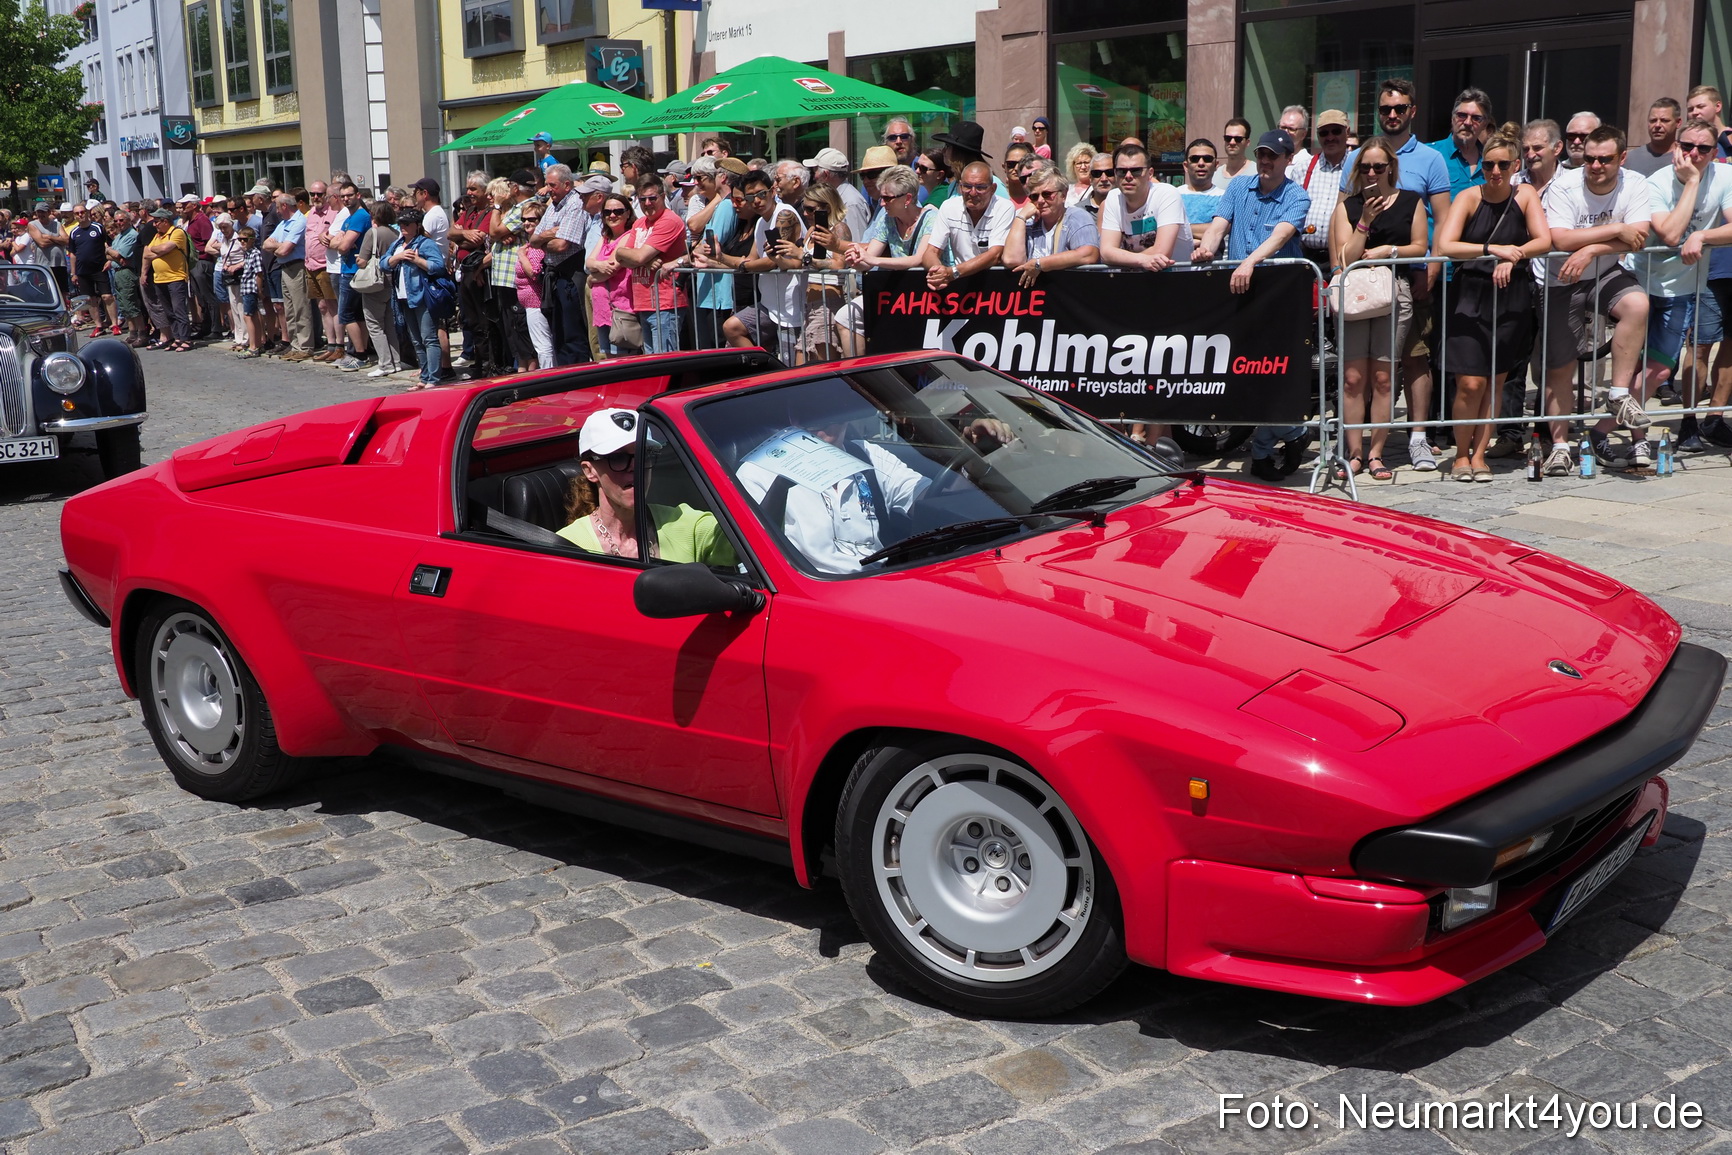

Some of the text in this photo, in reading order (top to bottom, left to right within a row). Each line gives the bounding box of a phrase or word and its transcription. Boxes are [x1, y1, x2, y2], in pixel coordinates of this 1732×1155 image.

[708, 24, 753, 42] Unterer Markt 15
[610, 56, 630, 82] G2
[800, 101, 890, 112] Lammsbräu
[803, 94, 867, 104] Neumarkter
[174, 125, 186, 138] G2
[578, 127, 603, 135] La
[877, 290, 1046, 316] FAHRSCHULE
[922, 318, 1289, 375] Kohlmann GmbH
[1077, 377, 1147, 397] Freystadt
[1156, 378, 1226, 398] Pyrbaum
